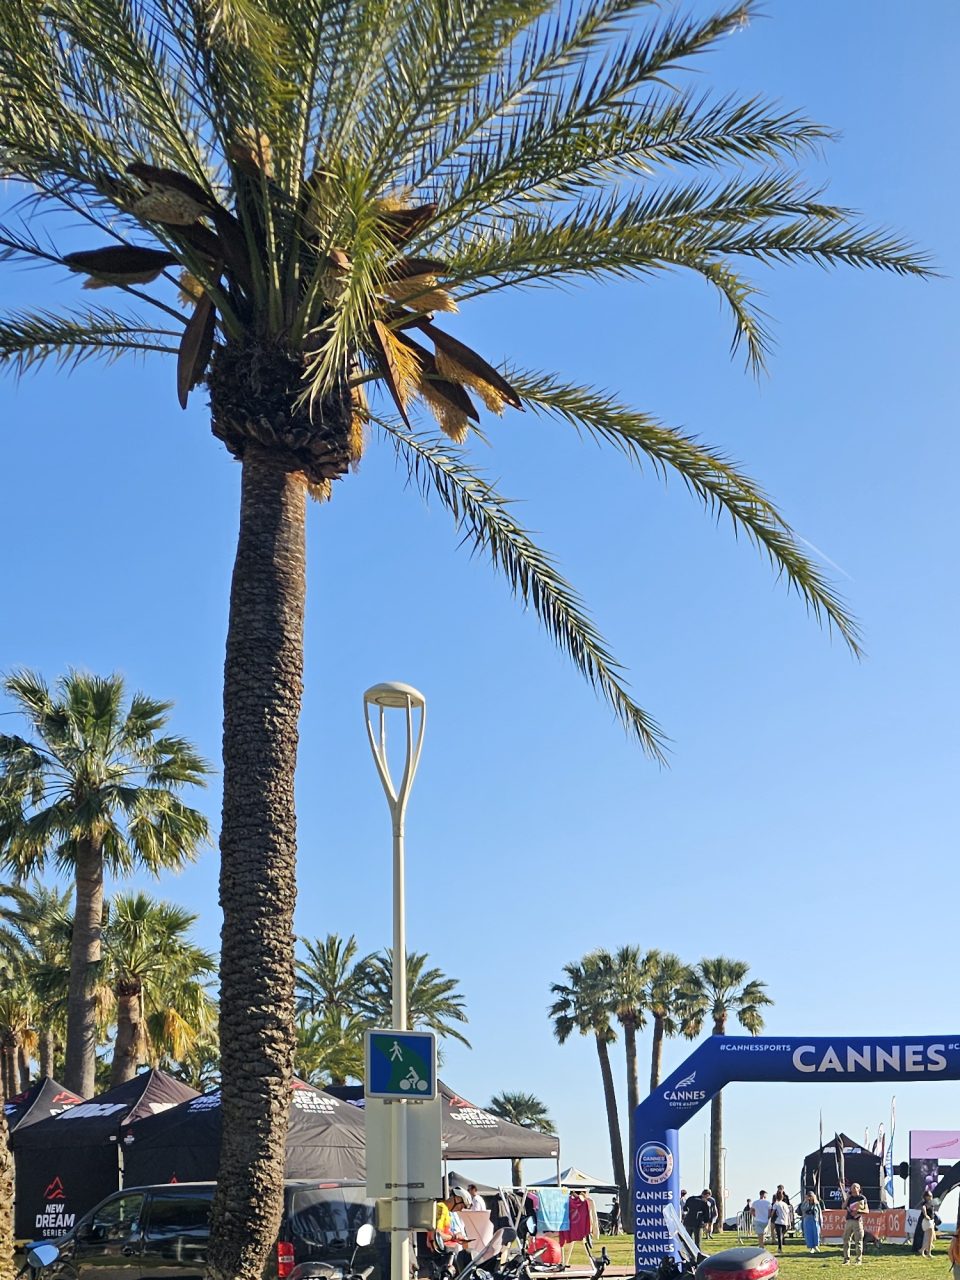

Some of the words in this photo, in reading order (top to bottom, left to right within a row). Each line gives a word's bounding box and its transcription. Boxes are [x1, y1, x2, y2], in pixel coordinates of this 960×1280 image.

[792, 1044, 947, 1073] CANNES
[663, 1090, 706, 1101] CANNES
[635, 1190, 673, 1200] CANNES
[45, 1203, 65, 1214] NEW
[35, 1213, 76, 1228] DREAM
[888, 1214, 900, 1232] 06
[42, 1229, 67, 1237] SERIES
[637, 1243, 675, 1253] CANNES
